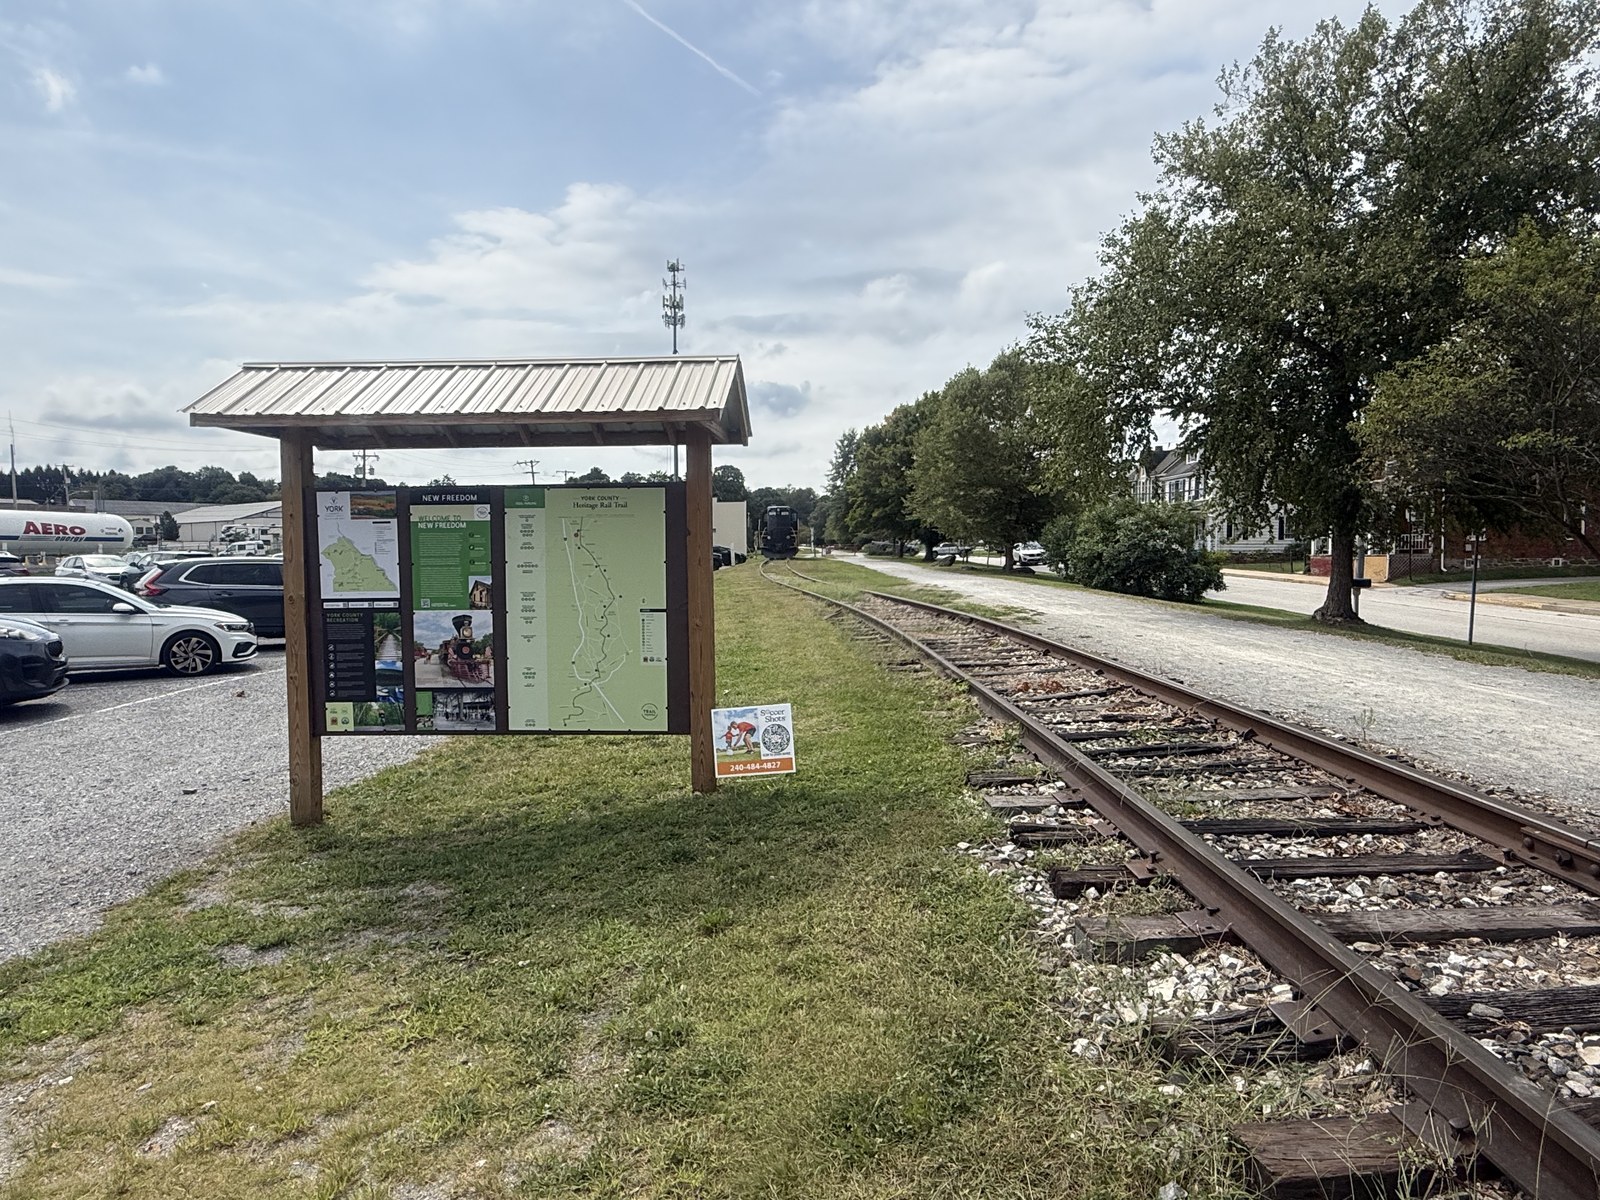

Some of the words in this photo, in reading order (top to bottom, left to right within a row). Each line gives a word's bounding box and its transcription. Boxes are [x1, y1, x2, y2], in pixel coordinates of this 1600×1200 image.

[325, 505, 344, 513] YORK
[573, 501, 599, 510] Heritage
[23, 521, 86, 535] AERO
[730, 761, 781, 772] 240-484-4827
